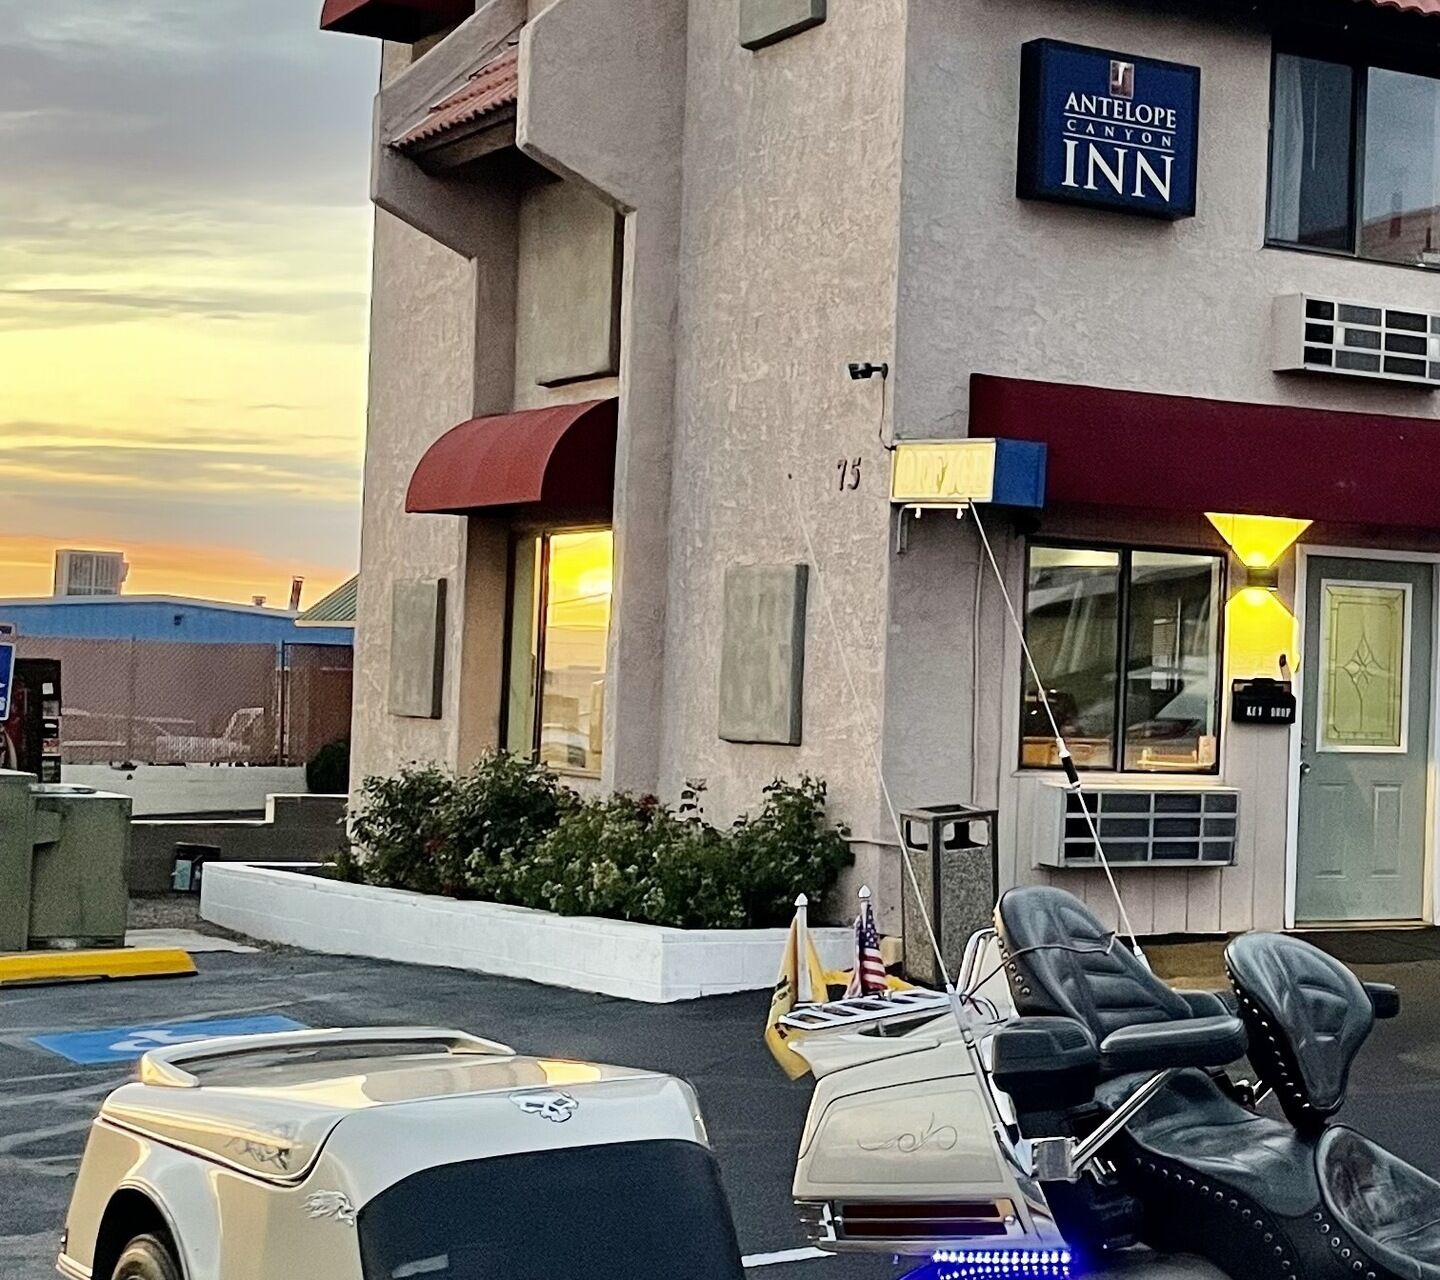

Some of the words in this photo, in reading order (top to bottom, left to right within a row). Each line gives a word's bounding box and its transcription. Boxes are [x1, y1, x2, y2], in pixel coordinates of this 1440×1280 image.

[1064, 91, 1177, 129] ANTELOPE
[1066, 119, 1172, 147] CANYON
[1061, 138, 1175, 202] INN
